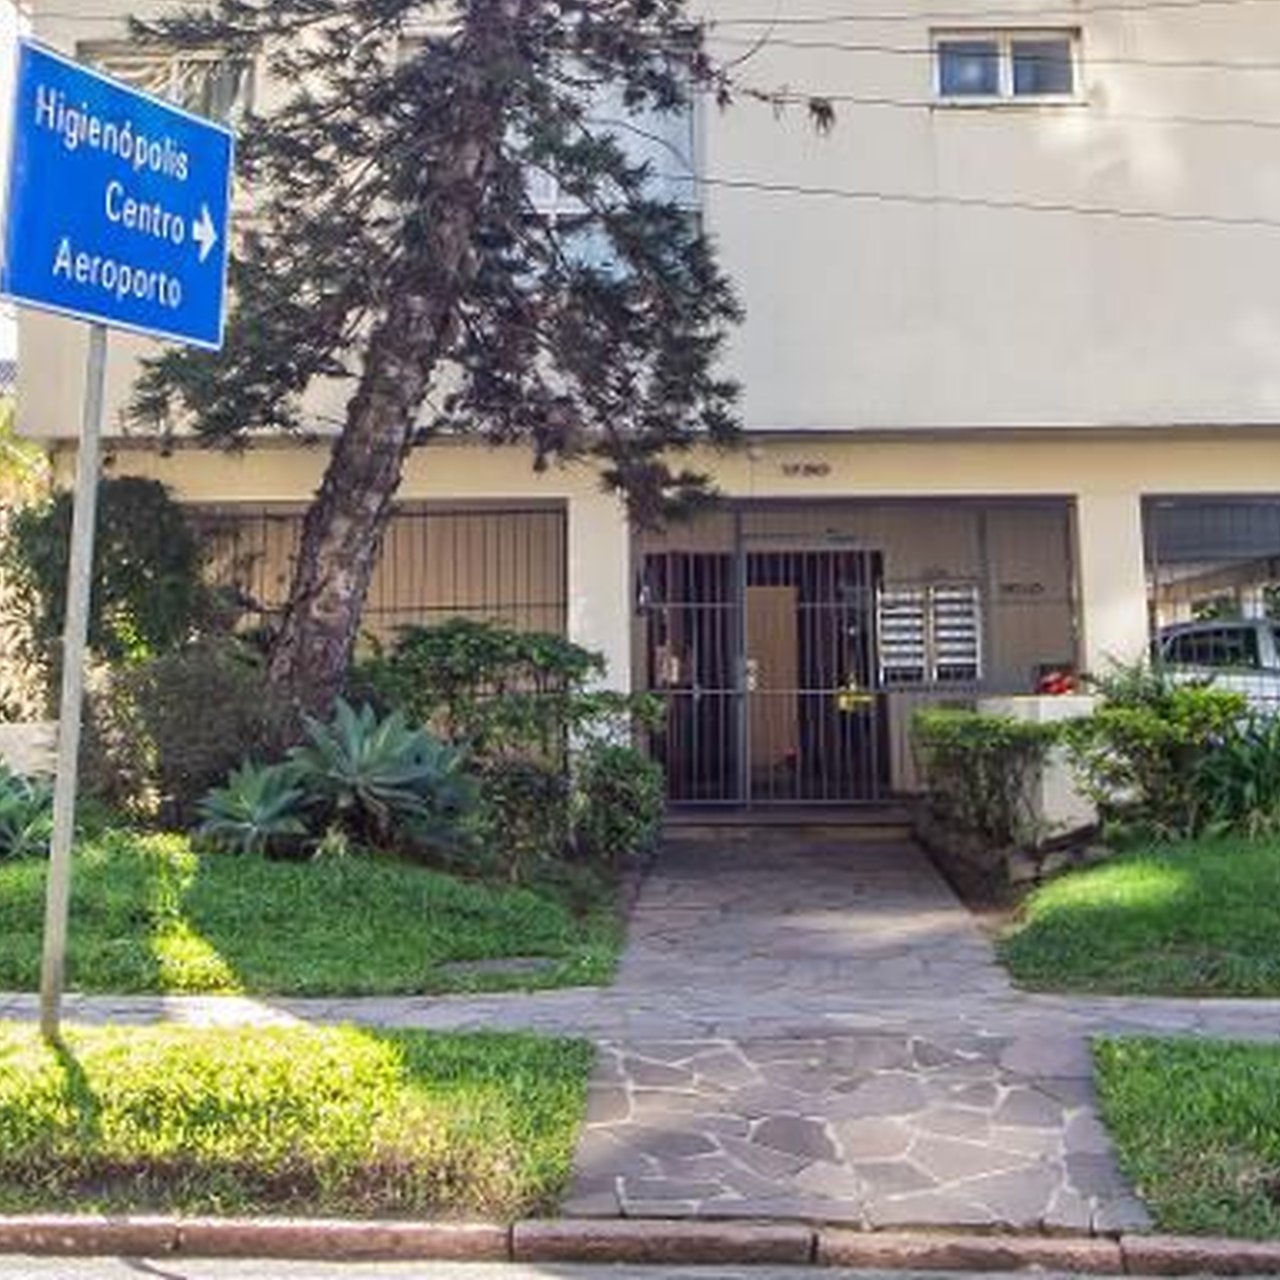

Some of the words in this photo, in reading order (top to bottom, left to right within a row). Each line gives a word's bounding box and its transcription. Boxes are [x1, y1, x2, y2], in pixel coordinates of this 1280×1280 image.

[35, 85, 188, 181] Higienópolis
[105, 181, 185, 244] Centro
[53, 238, 182, 309] Aeroporto
